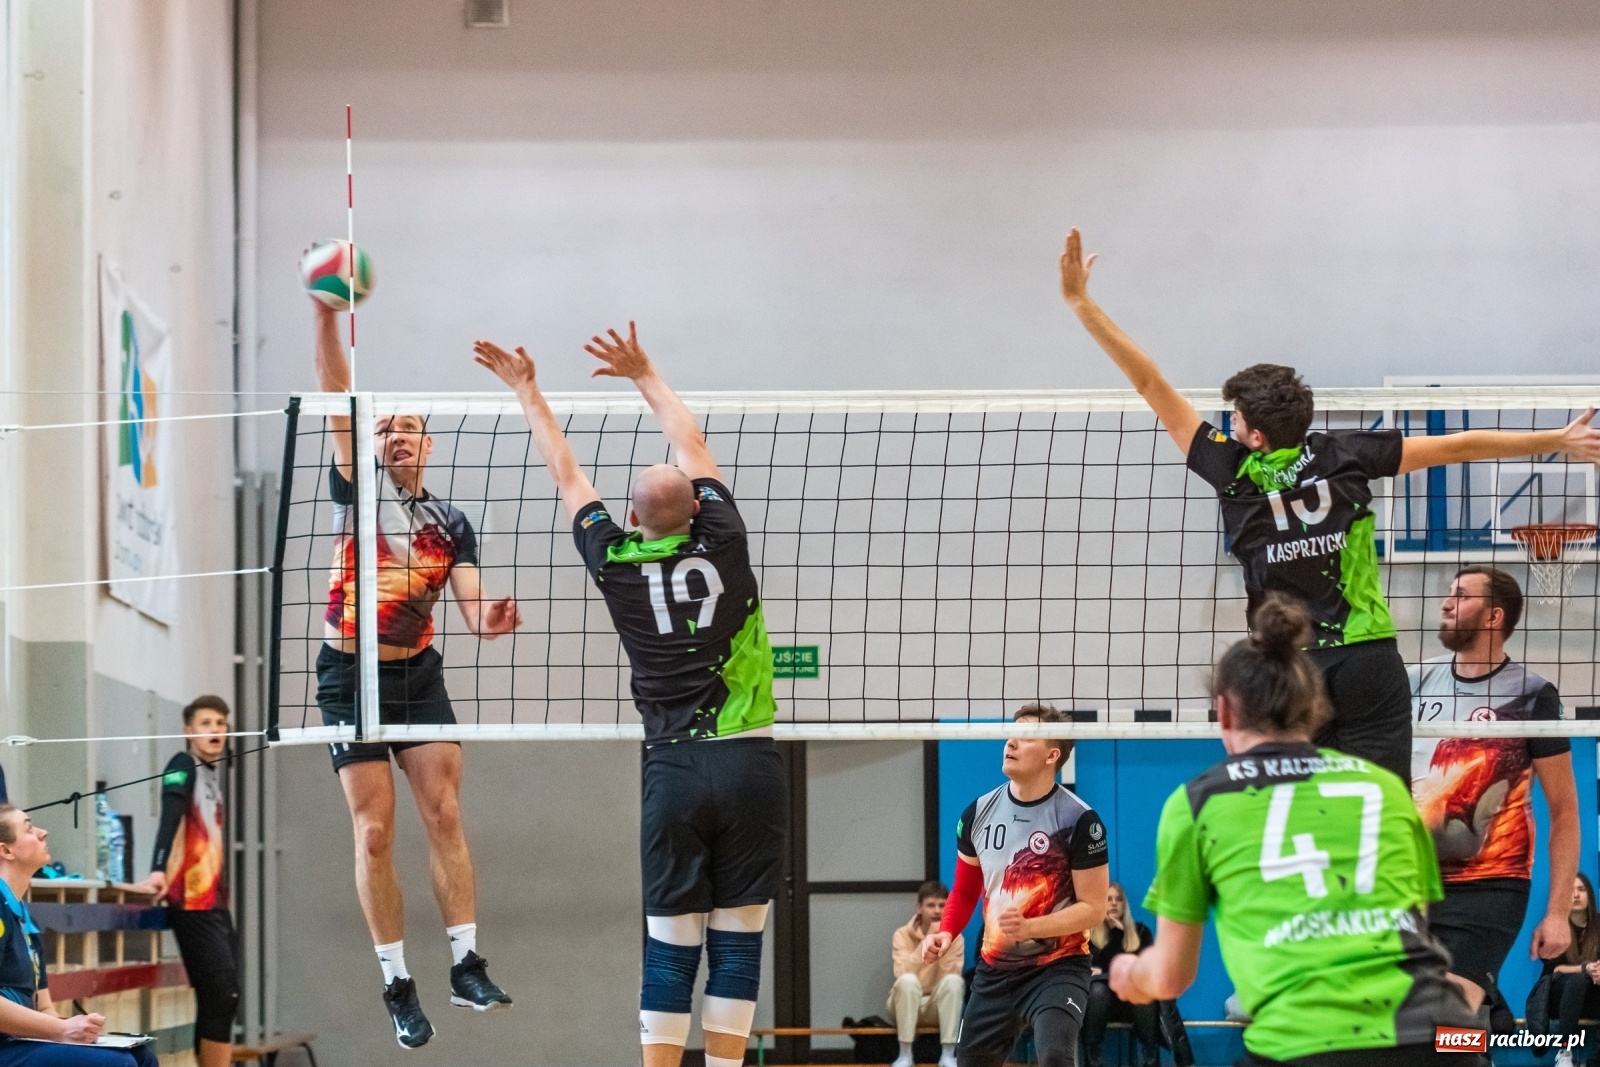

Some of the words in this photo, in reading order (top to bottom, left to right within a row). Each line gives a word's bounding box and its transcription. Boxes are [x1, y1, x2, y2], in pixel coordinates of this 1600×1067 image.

[1266, 531, 1348, 564] KASPRZYCKI
[641, 557, 725, 635] 19
[1418, 701, 1443, 722] 12
[1226, 760, 1259, 781] KS
[983, 823, 1007, 851] 10
[1259, 782, 1384, 898] 47
